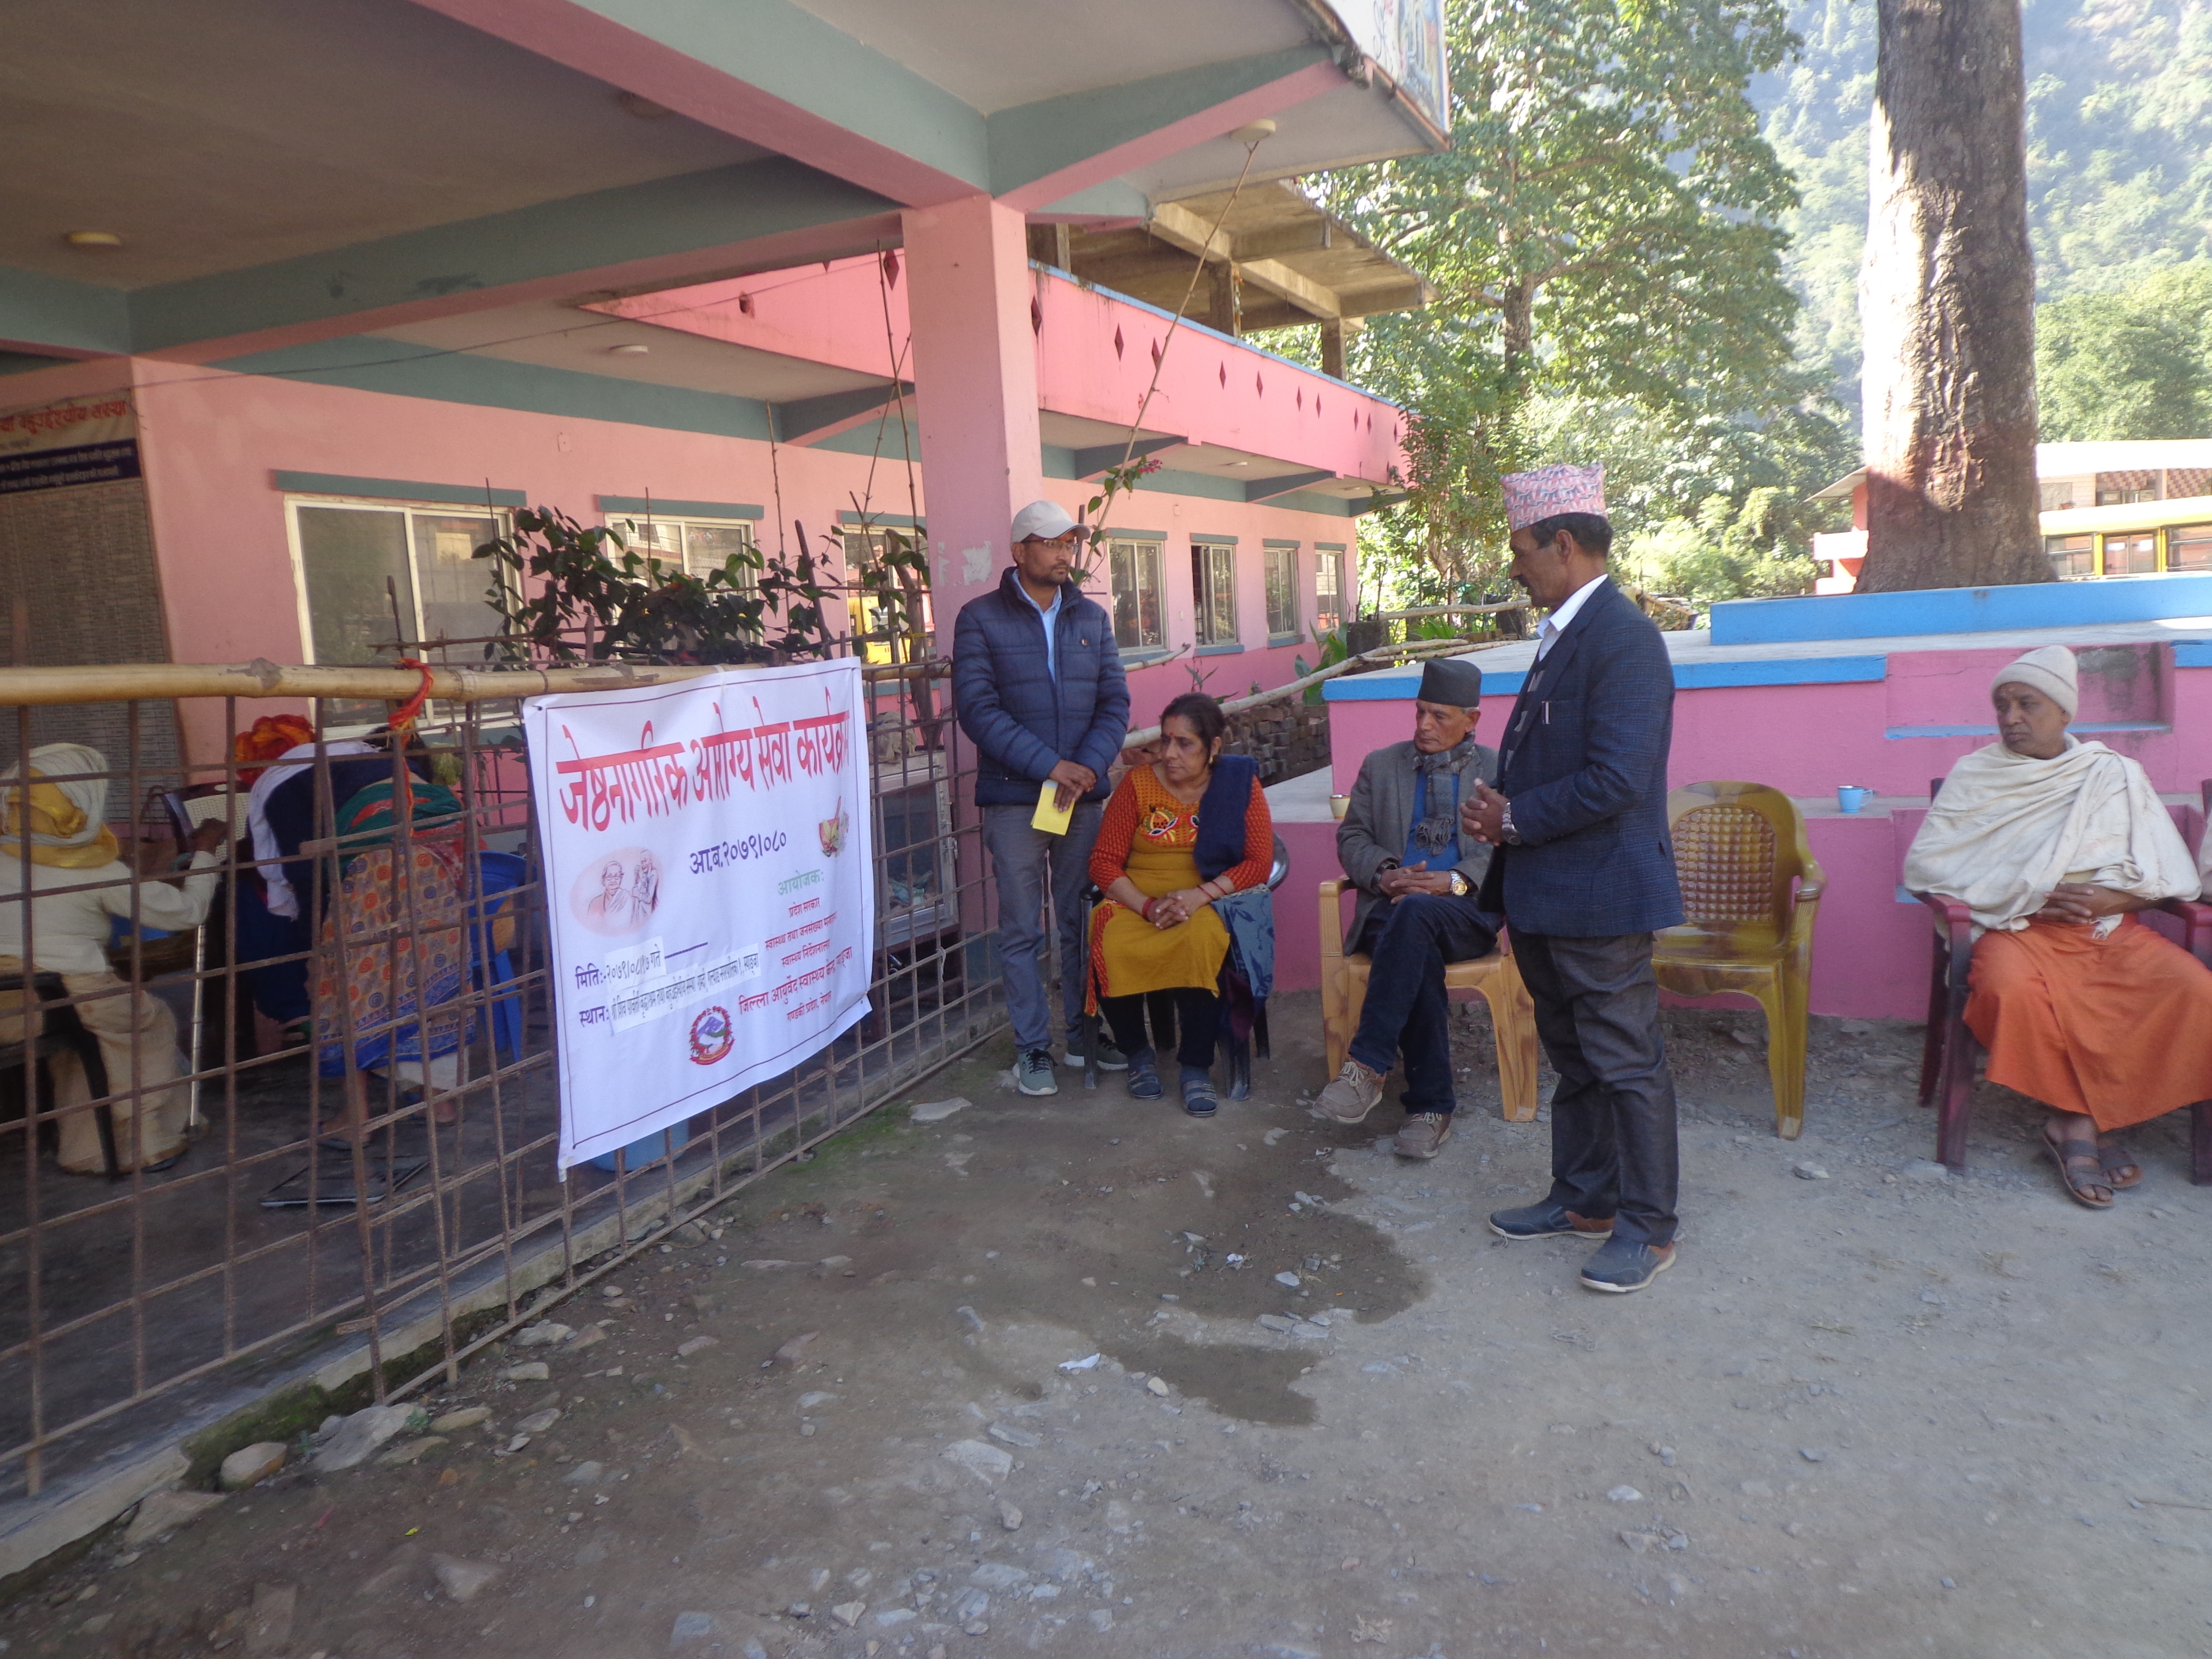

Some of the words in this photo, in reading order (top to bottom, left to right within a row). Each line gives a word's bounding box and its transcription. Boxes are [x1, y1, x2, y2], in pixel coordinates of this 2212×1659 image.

[690, 702, 756, 802] आरोग्य
[753, 696, 792, 792] सेवा
[789, 902, 802, 917] प्रदेश
[803, 897, 821, 913] सरकार
[787, 929, 798, 942] तथा
[799, 920, 823, 937] जनसंख्या
[738, 992, 769, 1015] जिल्ला
[771, 975, 798, 1005] आयुर्वेद
[798, 966, 825, 989] स्वास्थ्य
[787, 1002, 805, 1022] गण्डकी
